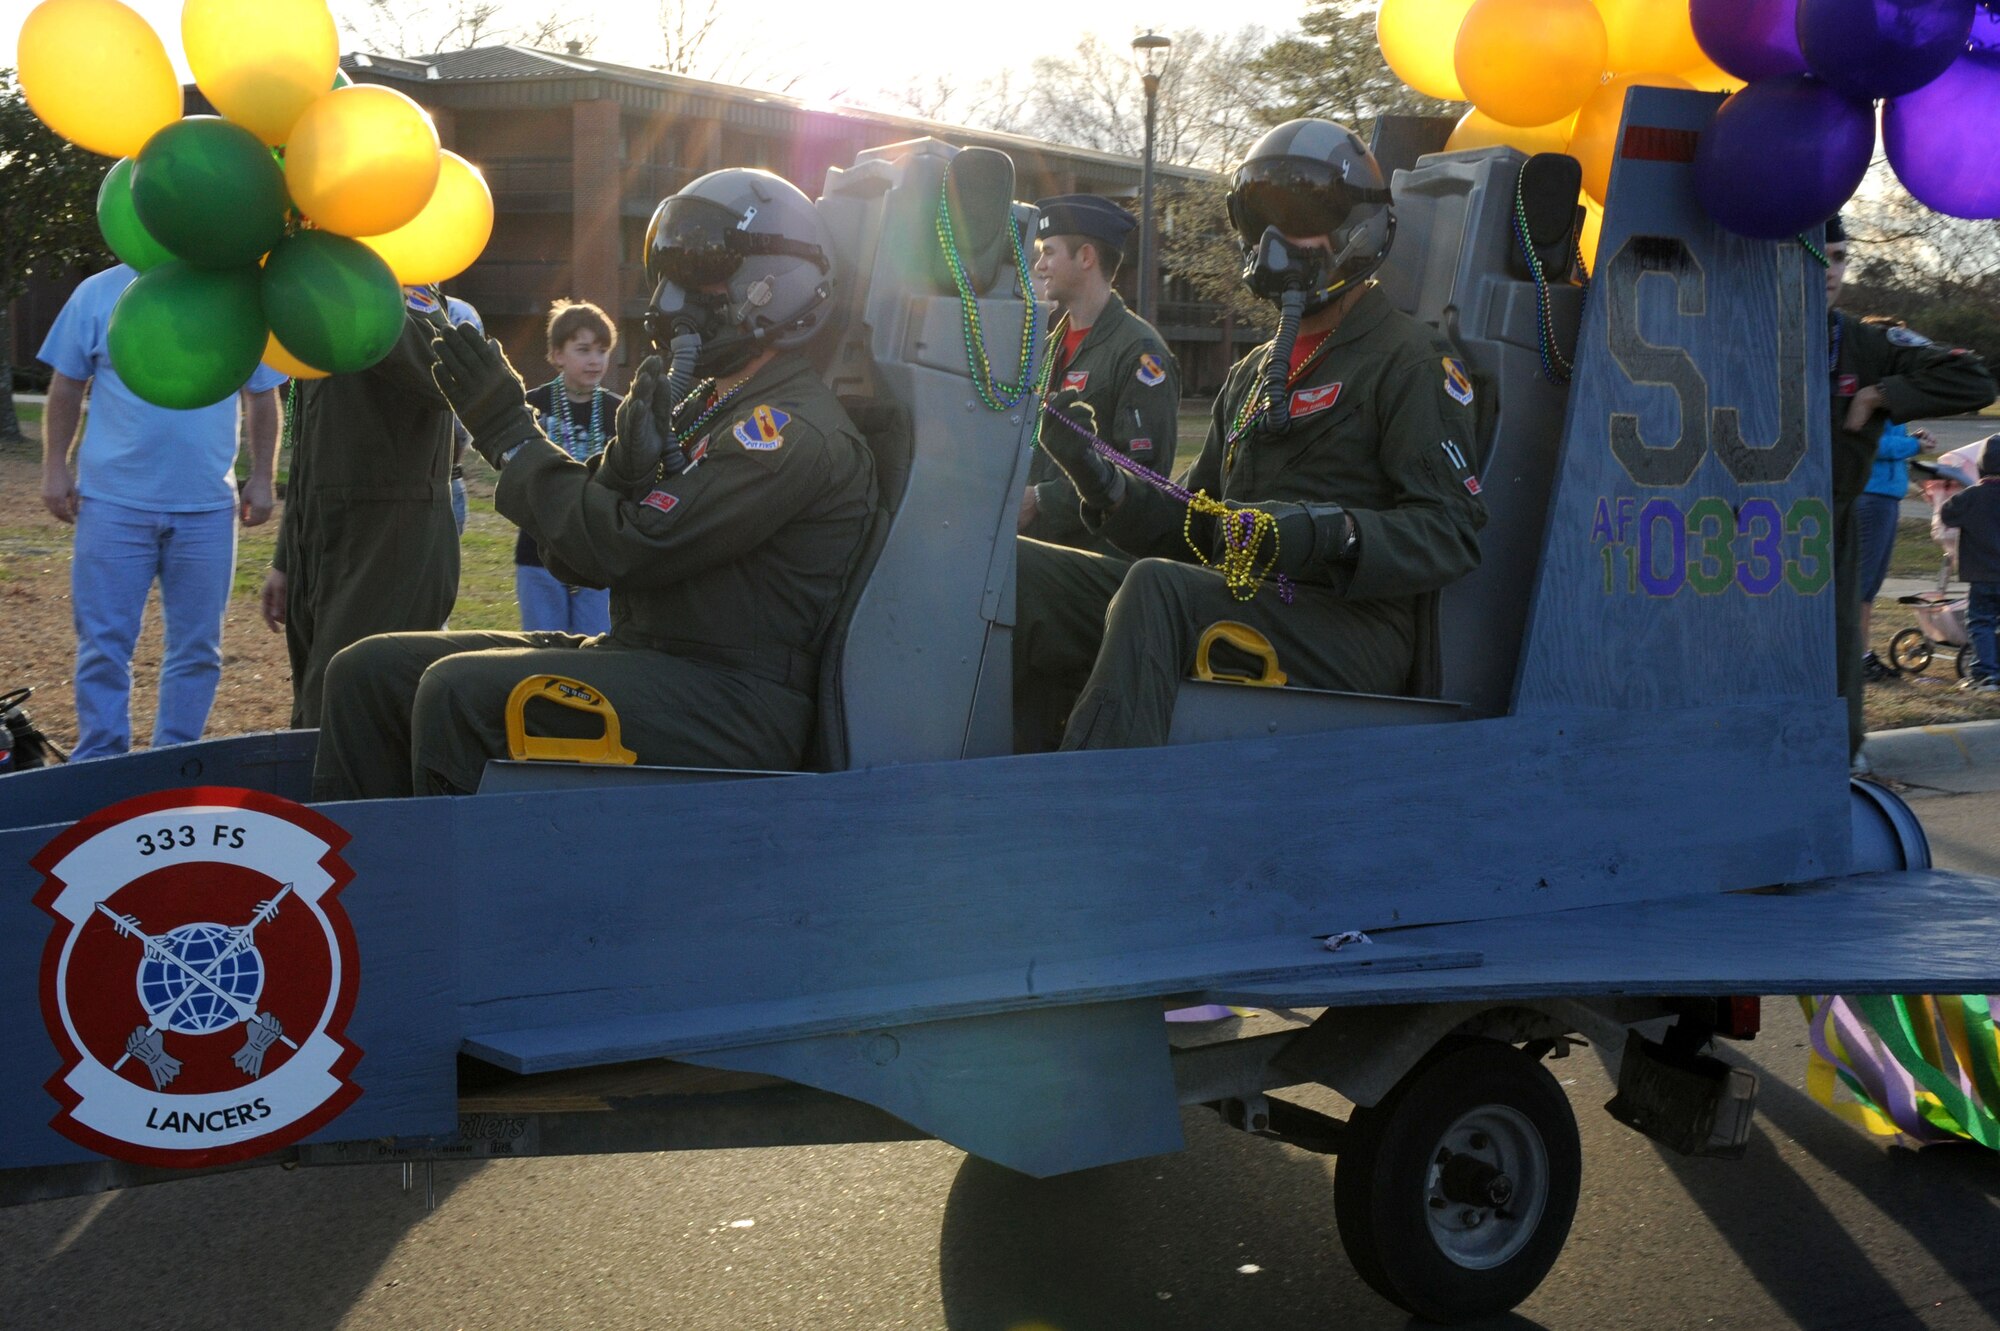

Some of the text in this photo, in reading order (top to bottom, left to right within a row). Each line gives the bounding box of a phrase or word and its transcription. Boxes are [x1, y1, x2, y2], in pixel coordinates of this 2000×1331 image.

[1606, 234, 1808, 487] SJ
[1590, 496, 1634, 544] AF
[1600, 545, 1637, 594] 11
[1638, 496, 1833, 597] 0333
[136, 824, 247, 856] 333 FS
[146, 1097, 272, 1133] LANCERS
